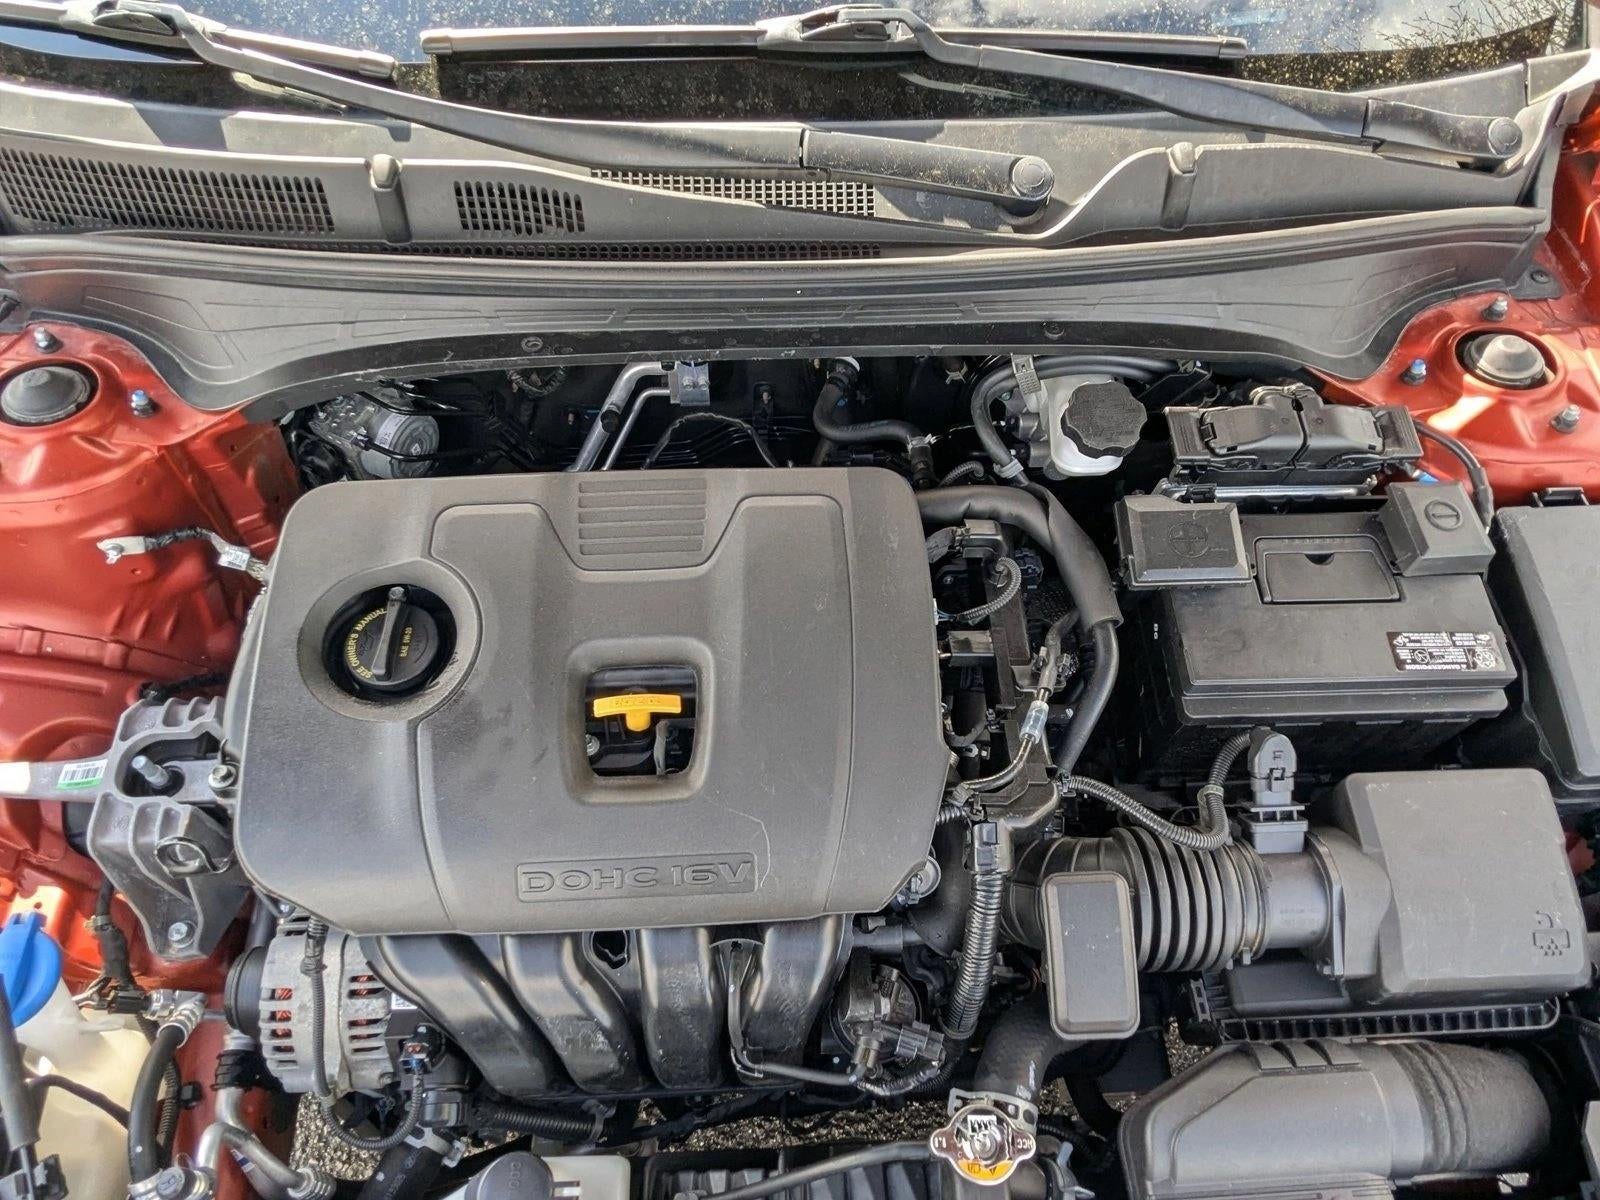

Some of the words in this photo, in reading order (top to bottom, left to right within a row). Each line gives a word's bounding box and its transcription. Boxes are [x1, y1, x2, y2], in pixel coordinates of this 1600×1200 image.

[355, 608, 388, 631] MANUAL
[357, 665, 374, 679] SEE
[522, 867, 659, 893] DOHC
[671, 861, 751, 886] 16V
